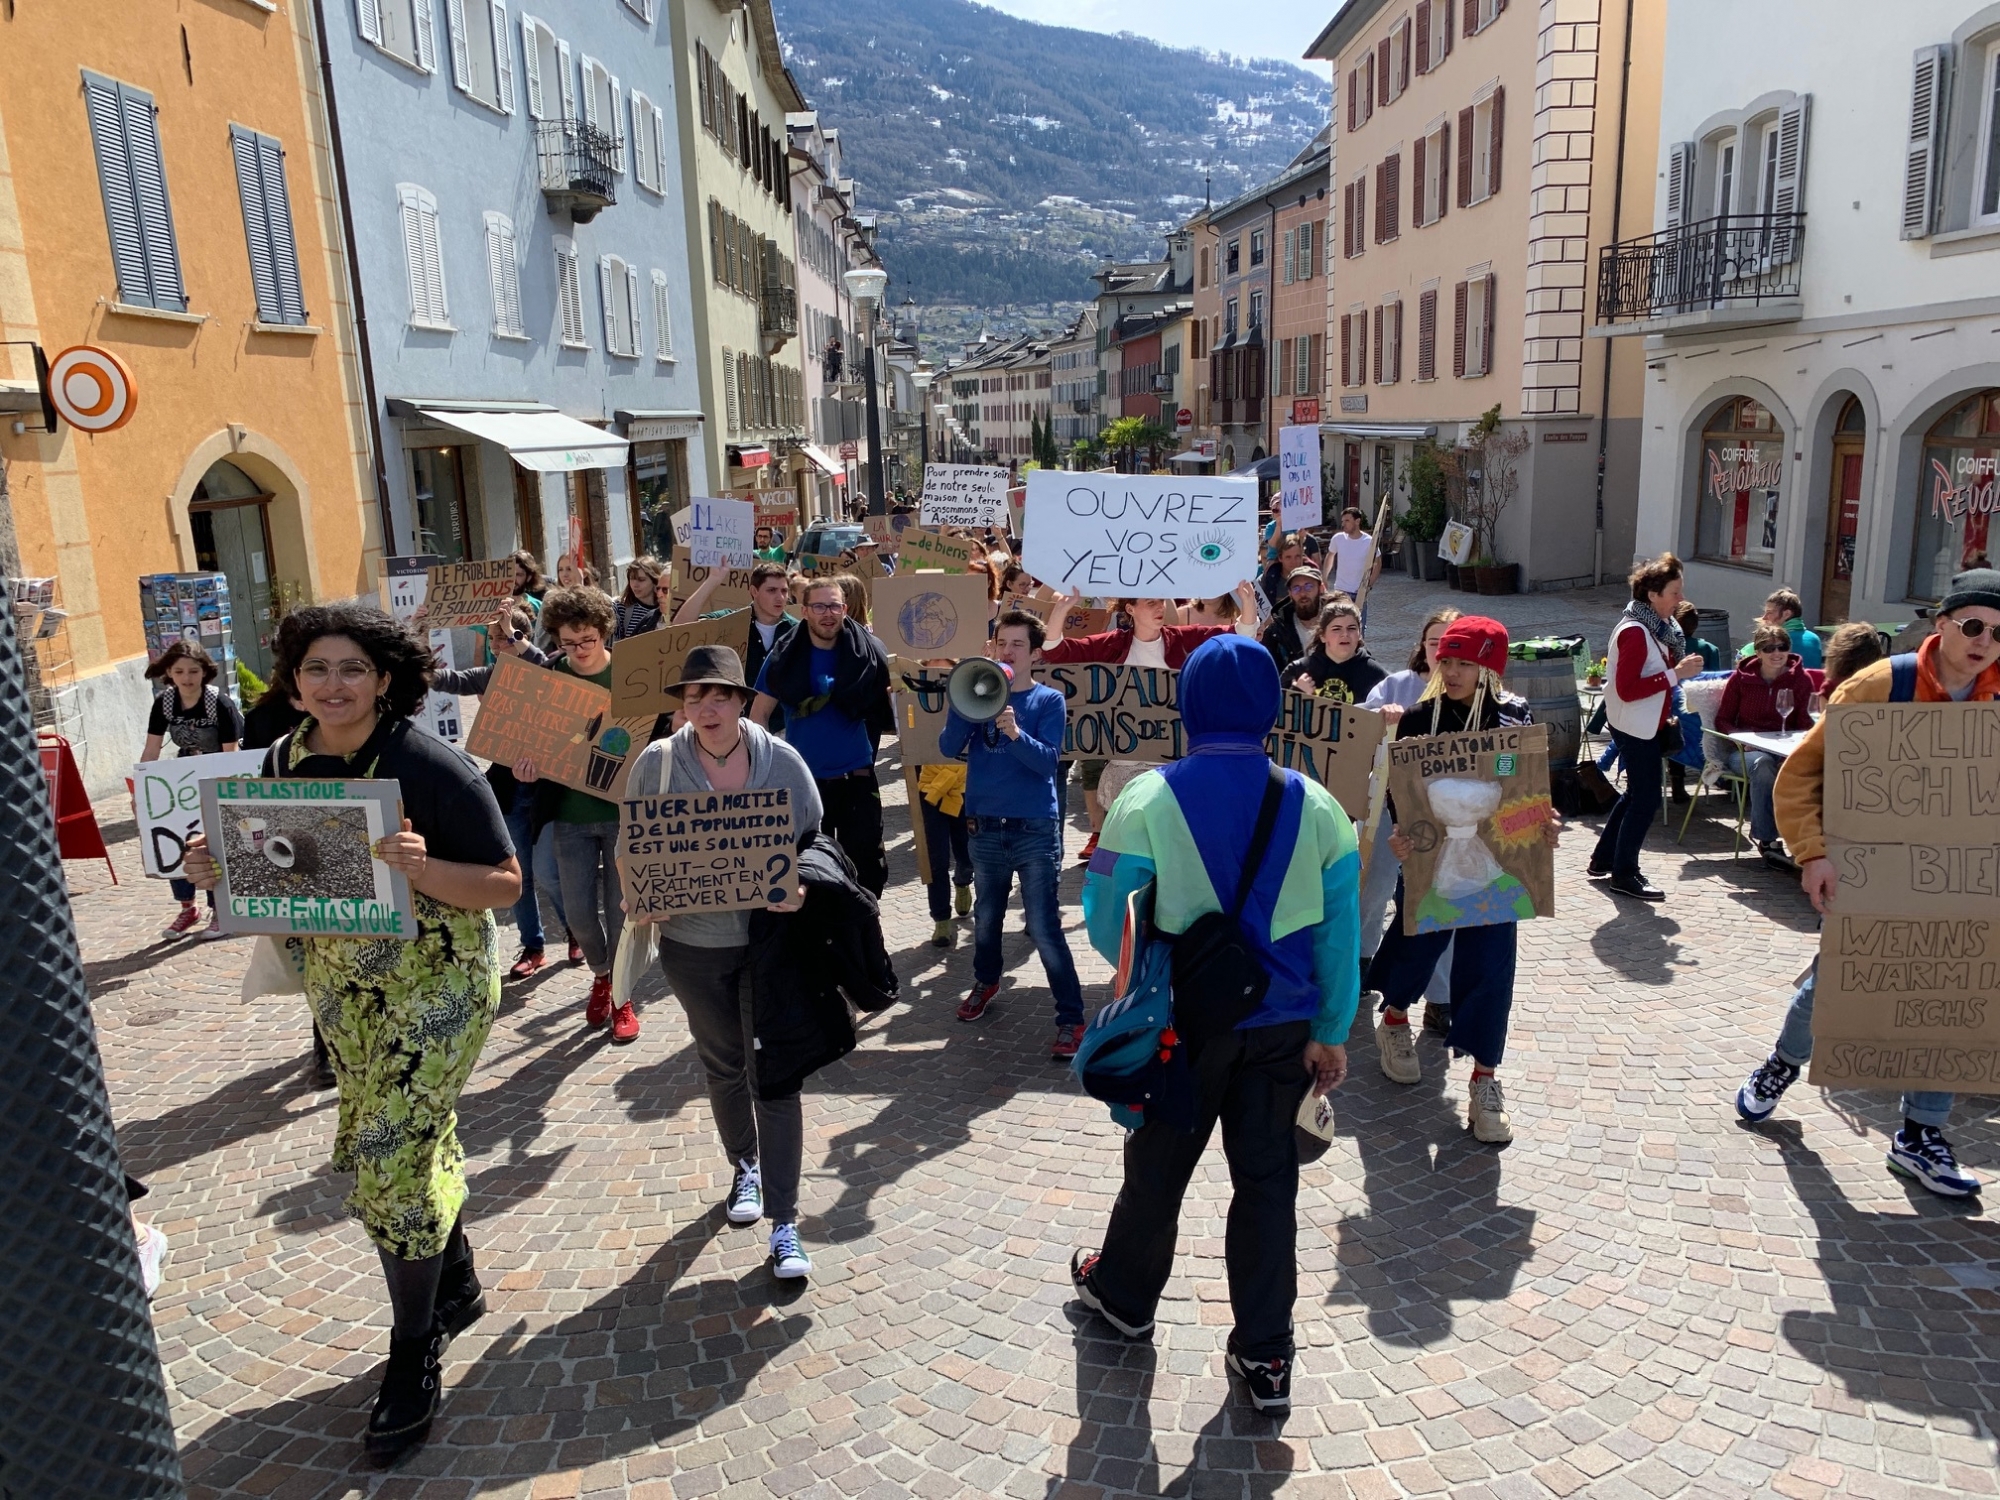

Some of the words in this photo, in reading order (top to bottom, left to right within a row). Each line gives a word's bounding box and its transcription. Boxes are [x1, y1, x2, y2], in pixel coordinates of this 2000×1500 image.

[1722, 448, 1760, 462] COIFFURE
[1957, 457, 2000, 475] COIFFU
[926, 466, 947, 477] Pour
[953, 468, 990, 479] prendre
[993, 469, 1010, 480] soin
[1708, 449, 1782, 505] REVOLUTIO
[759, 490, 796, 506] VACCIN
[925, 479, 937, 490] de
[940, 481, 968, 491] notre
[971, 482, 996, 493] seule
[1932, 458, 2000, 532] REVOL
[923, 503, 979, 514] Consommons
[964, 494, 973, 503] la
[978, 495, 1002, 506] terre
[1066, 487, 1247, 523] OUVREZ
[450, 501, 461, 541] TERROIRS
[692, 504, 738, 535] MAKE
[931, 512, 977, 526] Agissons
[693, 535, 709, 547] THE
[715, 536, 743, 551] EARTH
[935, 537, 969, 561] biens
[1105, 529, 1178, 554] VOS
[695, 549, 722, 565] GREAT
[1062, 549, 1178, 586] YEUX
[396, 567, 428, 575] VICTORINO
[435, 567, 450, 585] LE
[454, 560, 513, 582] PROBLEME
[431, 584, 466, 603] C'EST
[472, 580, 513, 598] VOUS
[659, 632, 690, 655] JO
[497, 664, 532, 694] NE
[537, 675, 611, 718] JETTEZ
[486, 690, 517, 715] PAS
[520, 703, 573, 734] NOTRE
[471, 732, 493, 755] LA
[1391, 742, 1446, 767] FUTURE
[1420, 754, 1476, 778] BOMB!
[217, 782, 241, 799] LE
[1841, 764, 1952, 817] ISCH
[623, 798, 690, 822] TUER
[694, 796, 718, 814] LA
[1500, 802, 1553, 836] BOOM!
[690, 813, 790, 833] POPULATION
[629, 840, 664, 855] EST
[669, 839, 700, 853] UNE
[704, 831, 795, 852] SOLUTION
[631, 871, 736, 896] VRAIMENT
[740, 869, 764, 884] EN
[1910, 844, 2000, 898] BIE
[635, 889, 728, 915] ARRIVER
[735, 880, 765, 903] LÀ
[1841, 960, 1970, 993] WARM
[1894, 997, 1988, 1029] ISCHS
